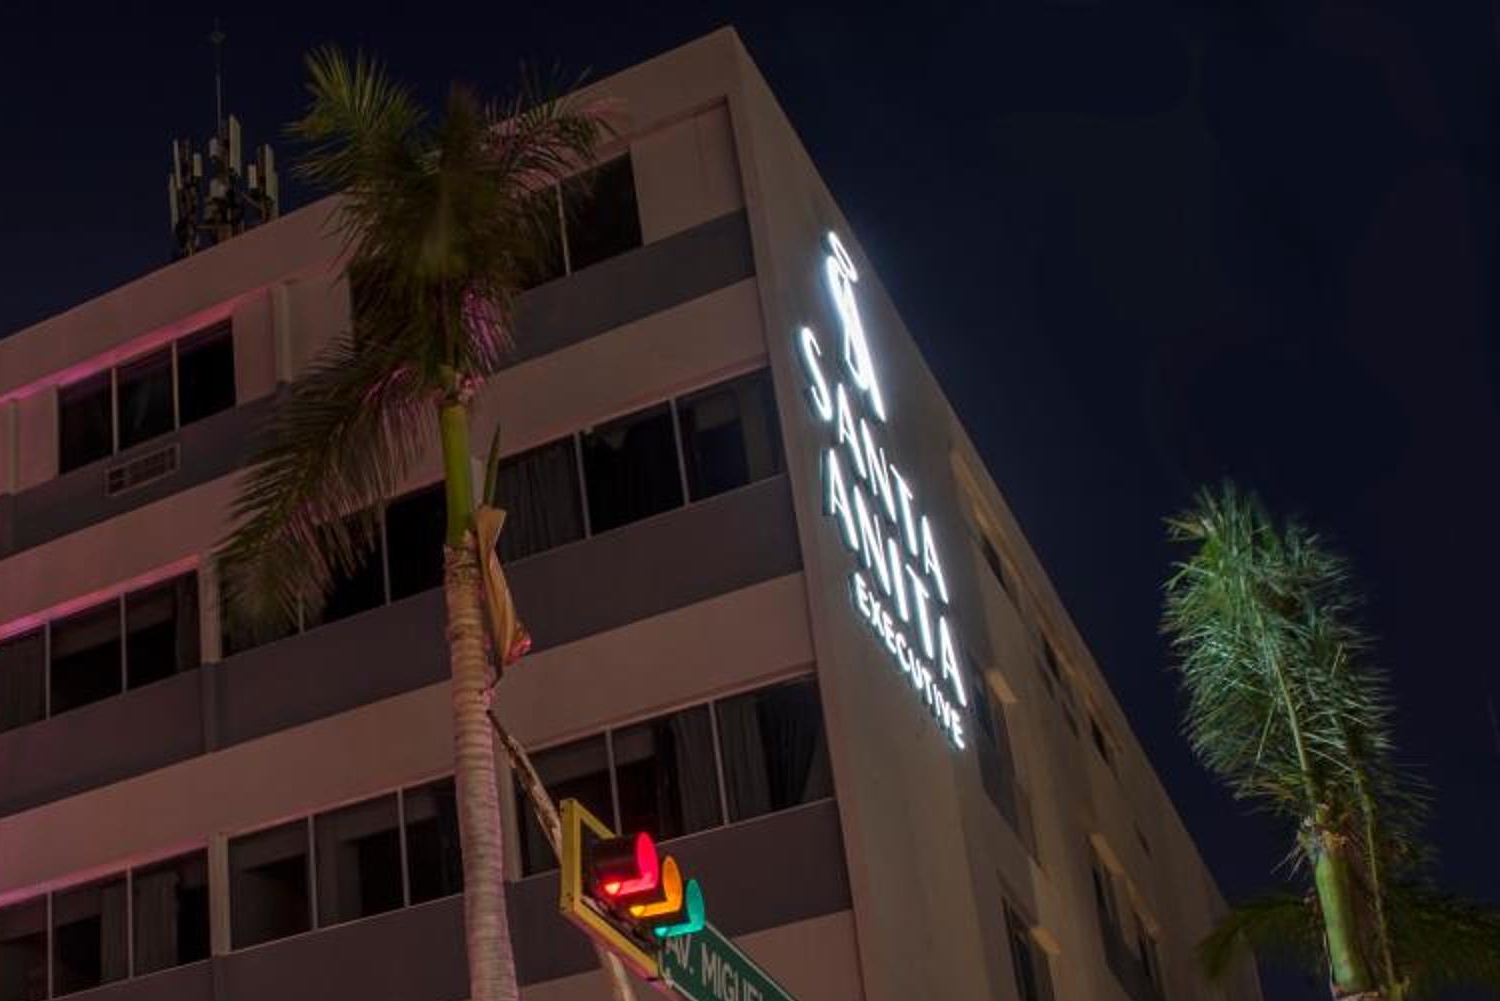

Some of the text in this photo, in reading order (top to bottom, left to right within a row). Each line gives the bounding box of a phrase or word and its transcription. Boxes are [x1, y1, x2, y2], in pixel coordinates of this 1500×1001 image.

[800, 325, 949, 604] SANTA
[825, 449, 967, 707] ANITA
[852, 573, 966, 750] EXECUTIVE
